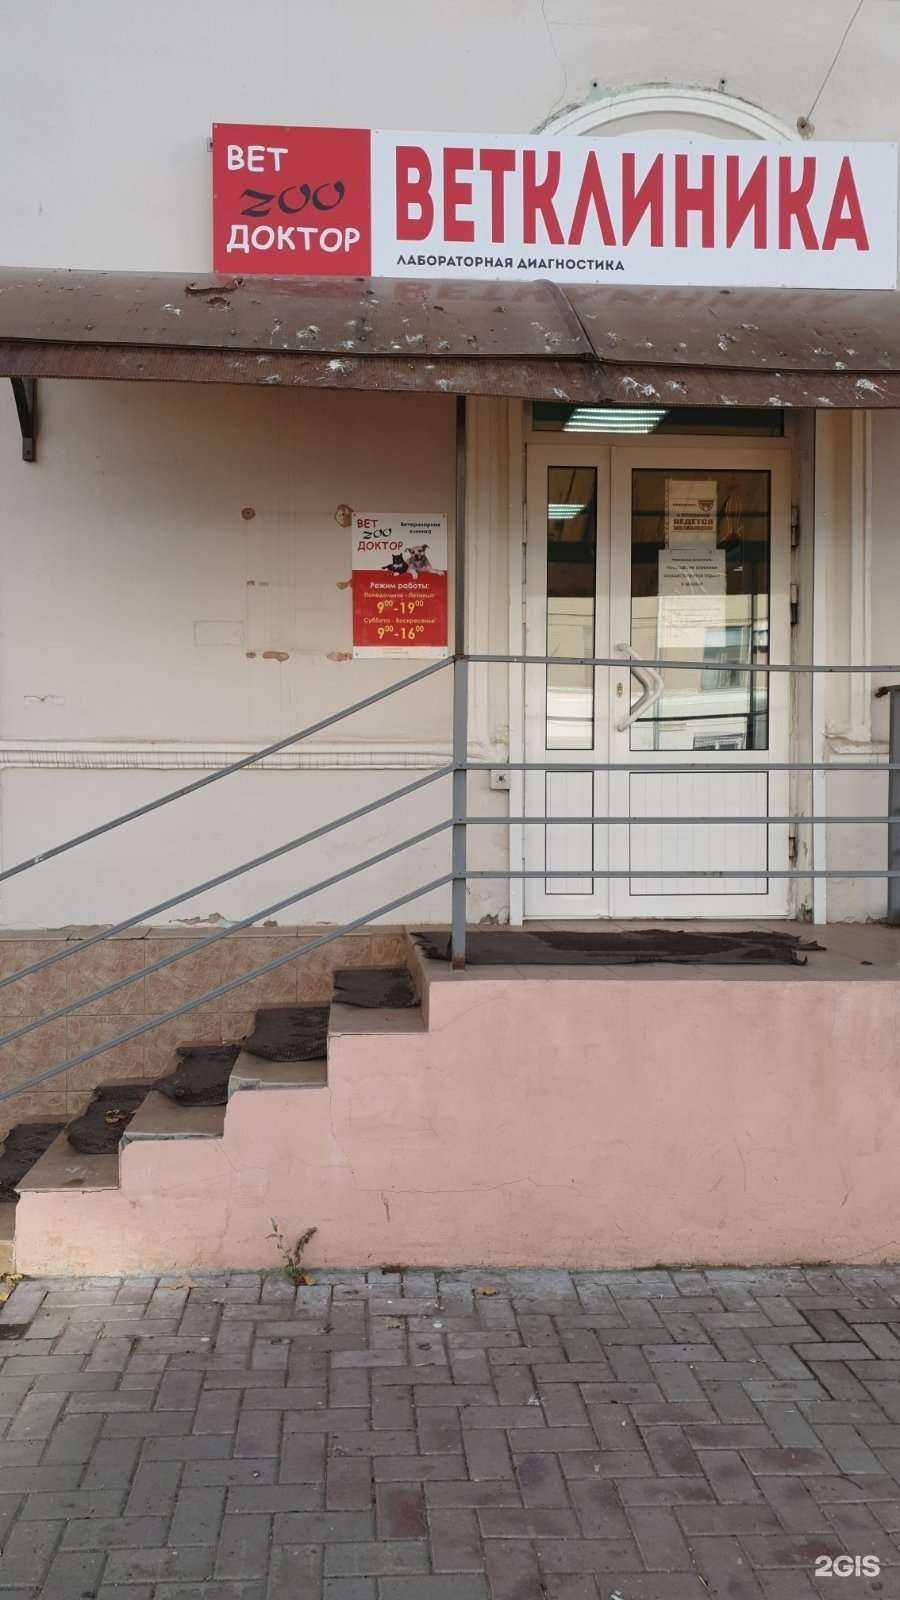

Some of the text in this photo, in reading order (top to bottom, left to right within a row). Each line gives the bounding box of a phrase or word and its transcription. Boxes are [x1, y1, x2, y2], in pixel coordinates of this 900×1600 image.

[227, 145, 288, 172] ВЕТ
[395, 145, 870, 251] ВЕТКЛИНИКА
[226, 224, 361, 254] ДОКТОР
[397, 254, 625, 271] ЛАБОРАТОРНАЯ ДИАГНОСТИКА
[357, 519, 379, 528] ВЕТ
[357, 541, 404, 552] ДОКТОР
